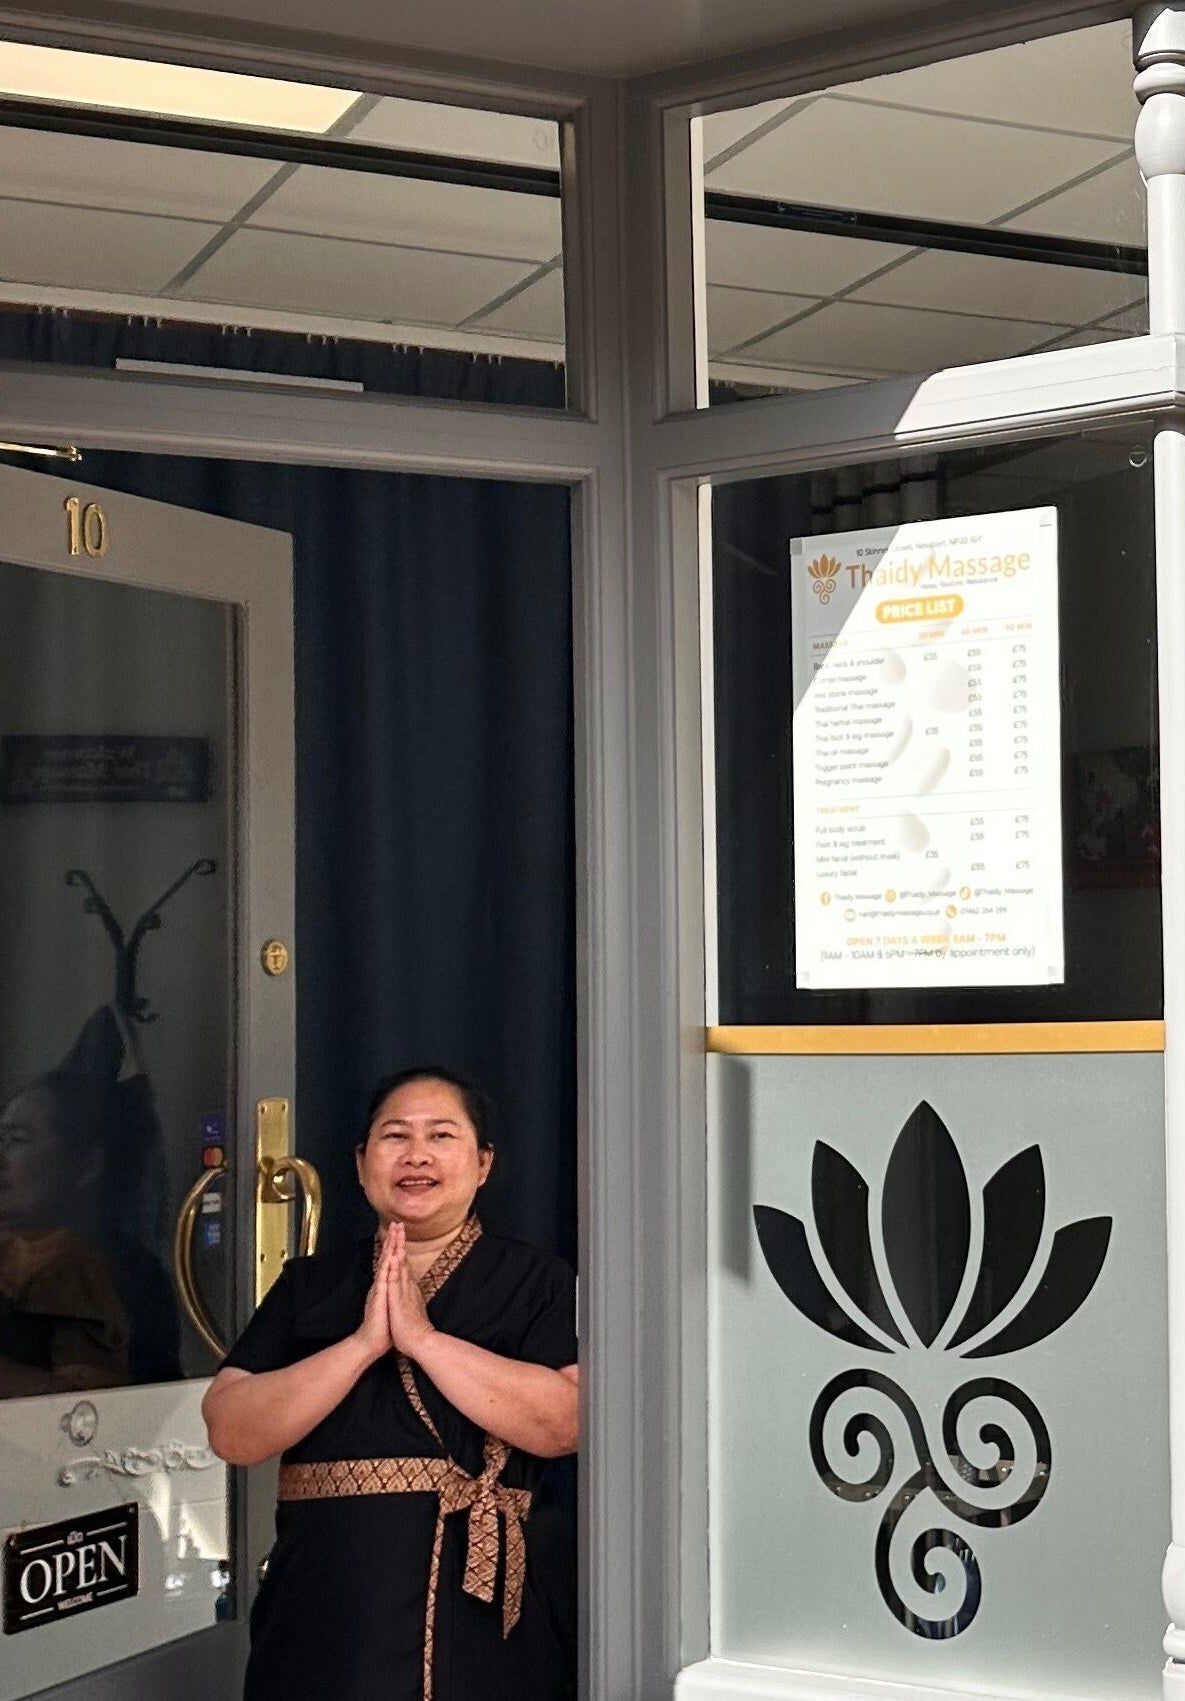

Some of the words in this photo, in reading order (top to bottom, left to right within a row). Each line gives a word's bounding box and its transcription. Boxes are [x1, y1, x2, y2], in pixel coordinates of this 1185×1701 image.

[64, 496, 108, 557] 10
[864, 545, 889, 556] Skinne
[845, 558, 922, 589] Thaidy
[928, 551, 1031, 581] Massage
[881, 601, 924, 620] PRICE
[925, 598, 957, 617] LIST
[1011, 644, 1027, 654] £75
[1012, 659, 1027, 669] £75
[1012, 673, 1028, 684] £75
[1013, 689, 1028, 699] £75
[1013, 704, 1028, 714] £75
[1013, 719, 1029, 729] £75
[1013, 735, 1029, 744] £75
[1014, 750, 1029, 760] £75
[1014, 765, 1029, 775] £75
[969, 817, 985, 827] £55
[1014, 814, 1030, 824] £75
[1014, 829, 1030, 839] £75
[1015, 860, 1031, 870] £75
[846, 936, 873, 947] OPEN
[876, 936, 882, 946] 7
[883, 935, 909, 946] DAYS
[911, 935, 918, 945] A
[920, 933, 950, 945] WEEK
[953, 932, 976, 944] 9AM
[985, 932, 1007, 943] 7PM
[851, 949, 875, 960] 10AM
[949, 946, 1011, 959] appointment
[1012, 944, 1036, 959] only)
[20, 1535, 127, 1604] OPEN
